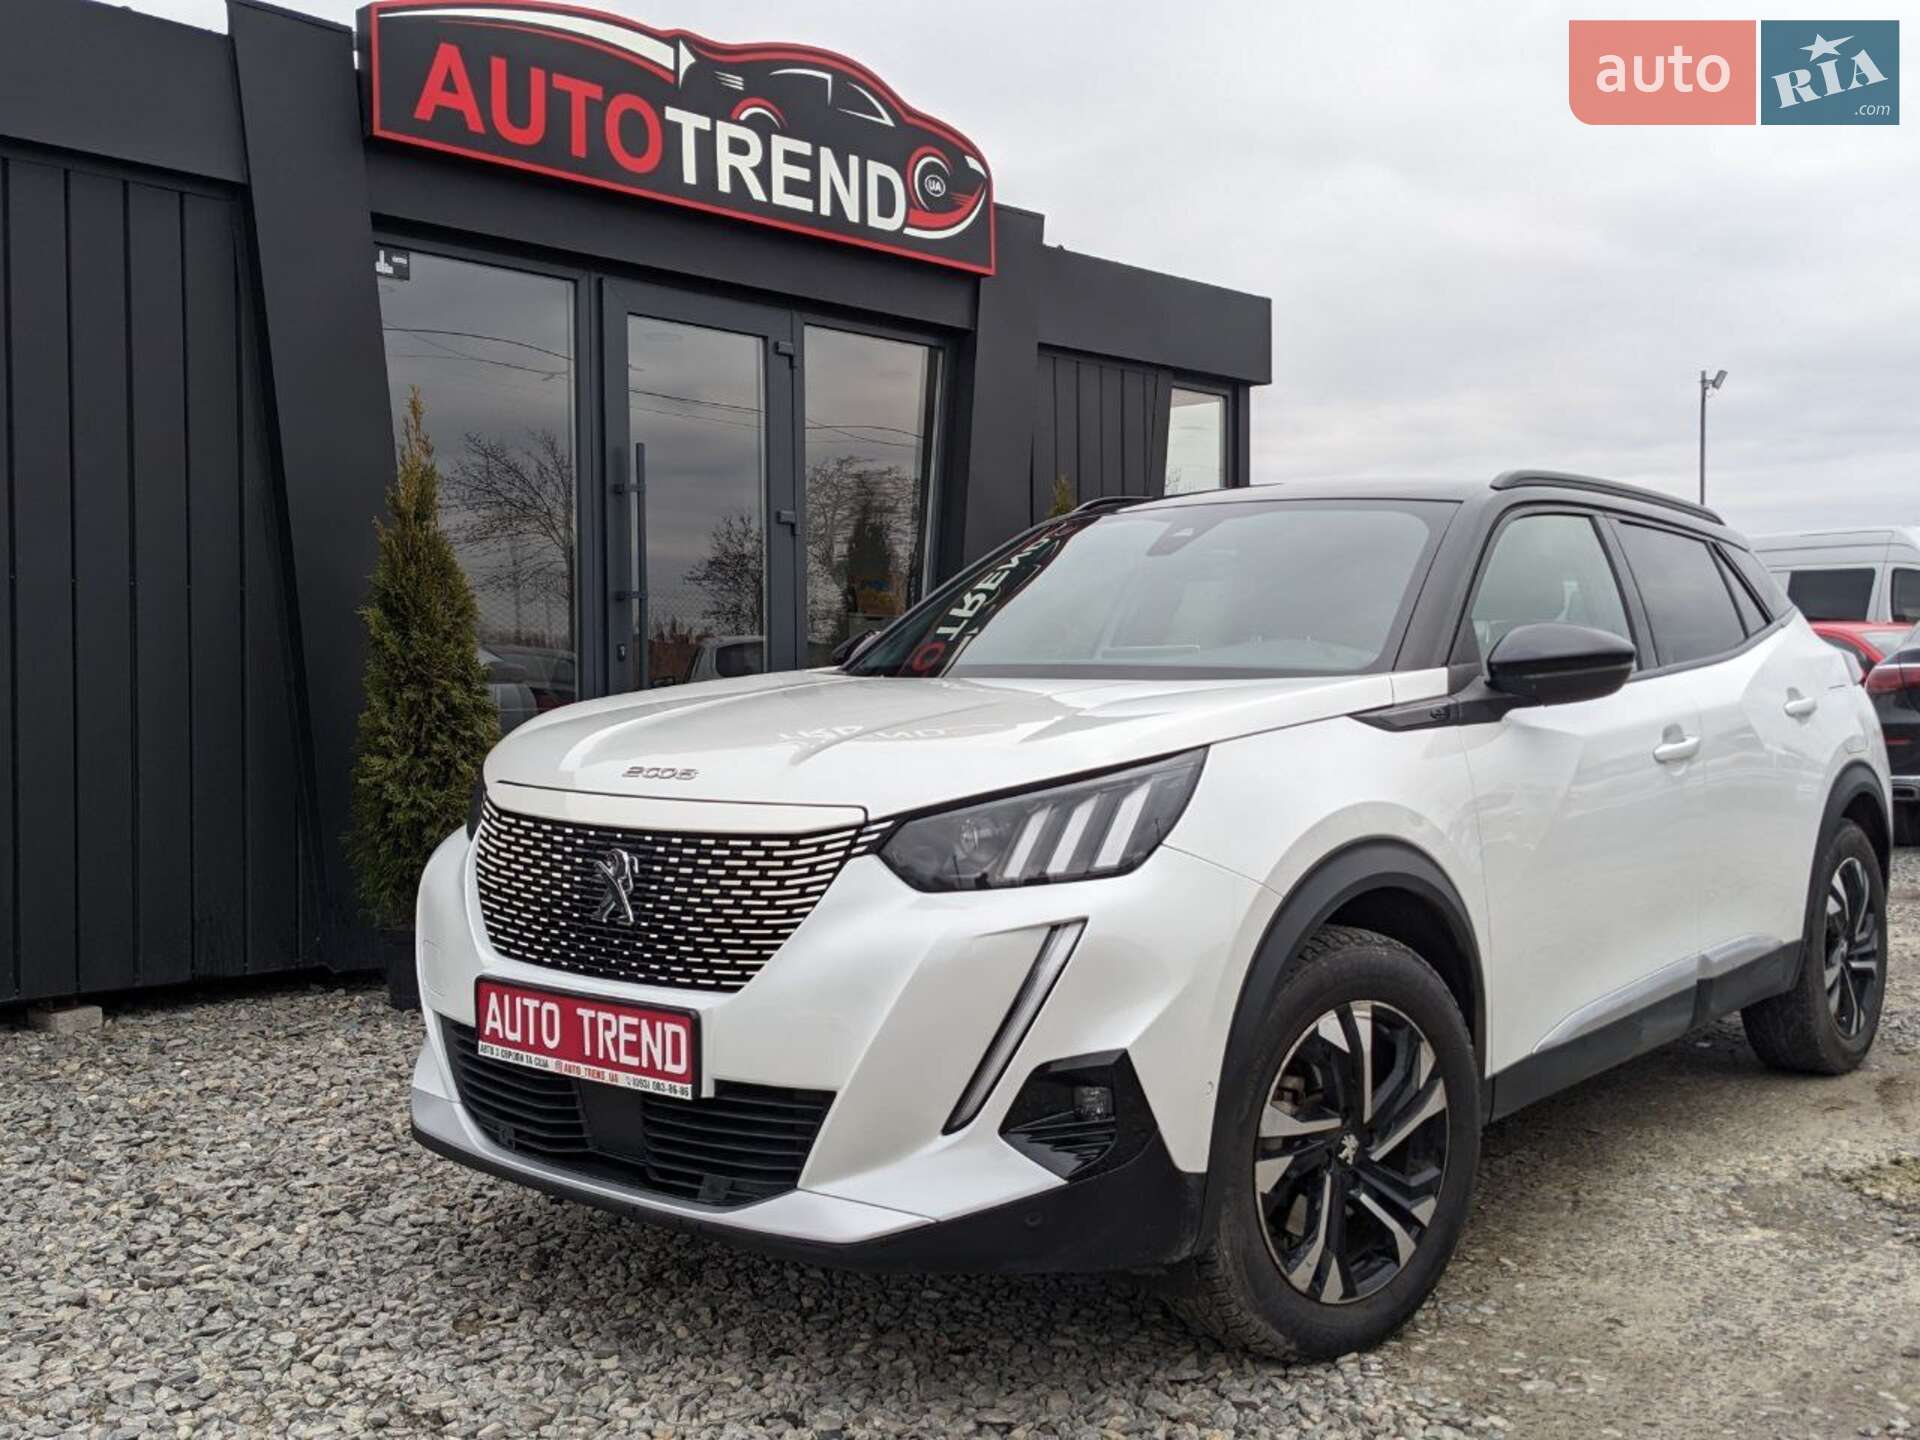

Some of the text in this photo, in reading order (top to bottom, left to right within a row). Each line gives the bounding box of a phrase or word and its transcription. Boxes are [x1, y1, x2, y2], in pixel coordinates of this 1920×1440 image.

[928, 179, 943, 193] UA
[622, 766, 699, 781] 2008
[484, 991, 688, 1076] AUTO TREND
